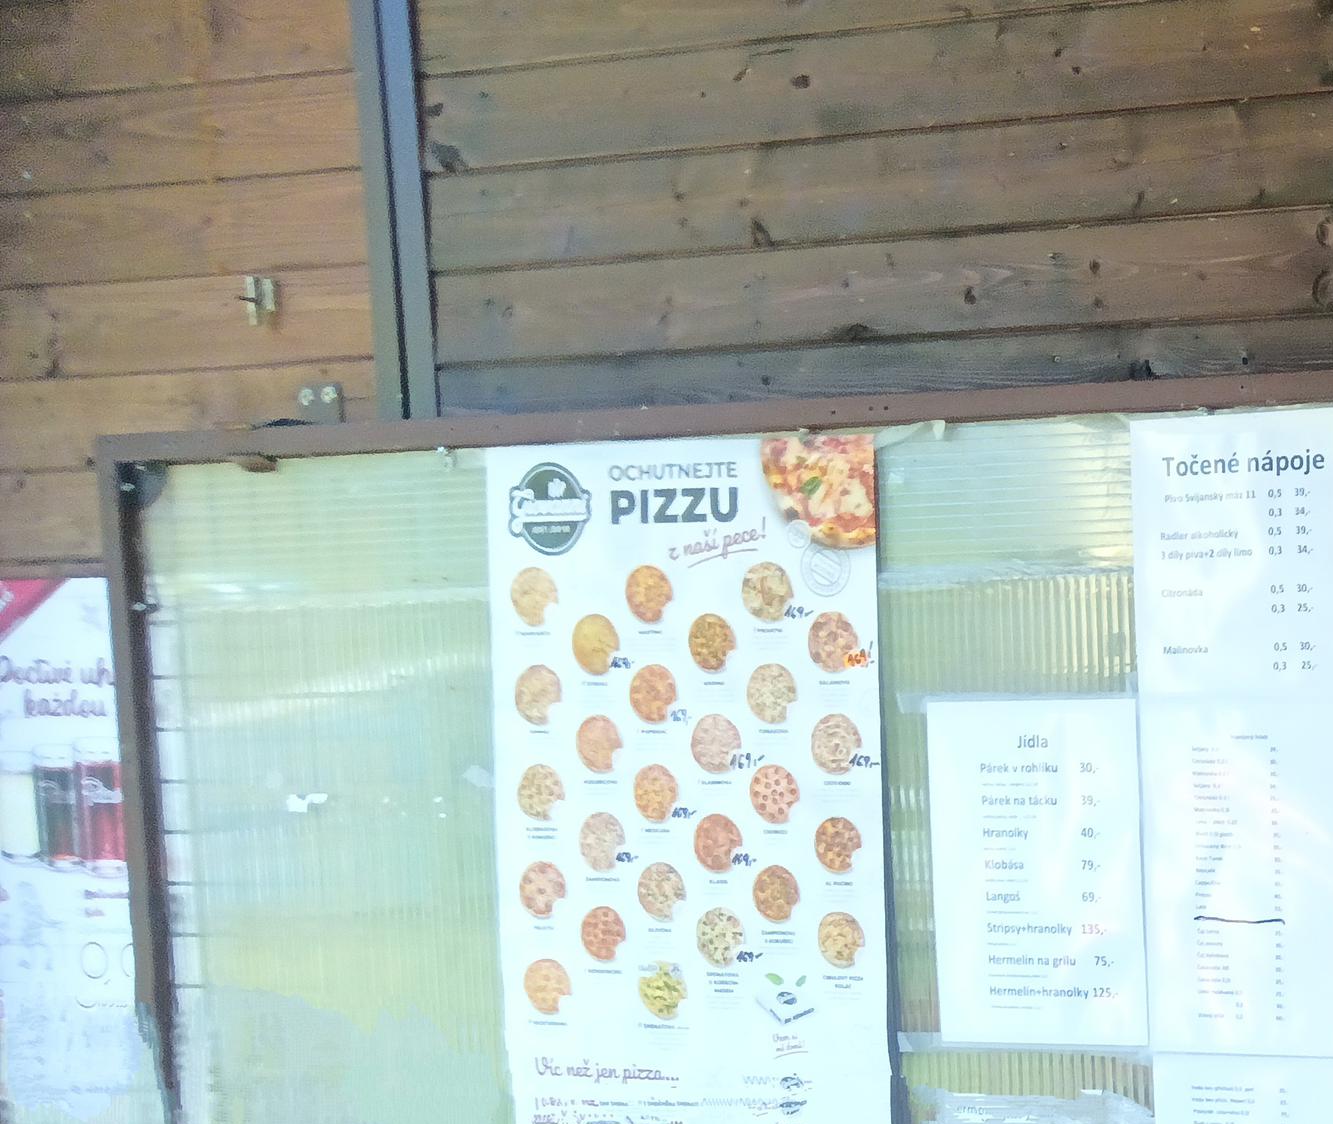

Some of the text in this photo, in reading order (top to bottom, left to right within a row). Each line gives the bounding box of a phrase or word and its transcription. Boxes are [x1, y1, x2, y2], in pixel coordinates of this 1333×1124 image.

[1162, 449, 1325, 477] Točené nápoje
[608, 461, 738, 482] OCHUTNEJTE
[1268, 488, 1282, 499] 0,5
[610, 486, 739, 526] PIZZU
[1268, 507, 1282, 518] 0,3
[1268, 526, 1282, 537] 0,5
[1268, 546, 1282, 557] 0,3
[1270, 584, 1284, 595] 0,5
[1271, 603, 1285, 615] 0,3
[1273, 641, 1288, 653] 0,5
[1273, 660, 1287, 672] 0,3
[1017, 735, 1048, 749] Jídla
